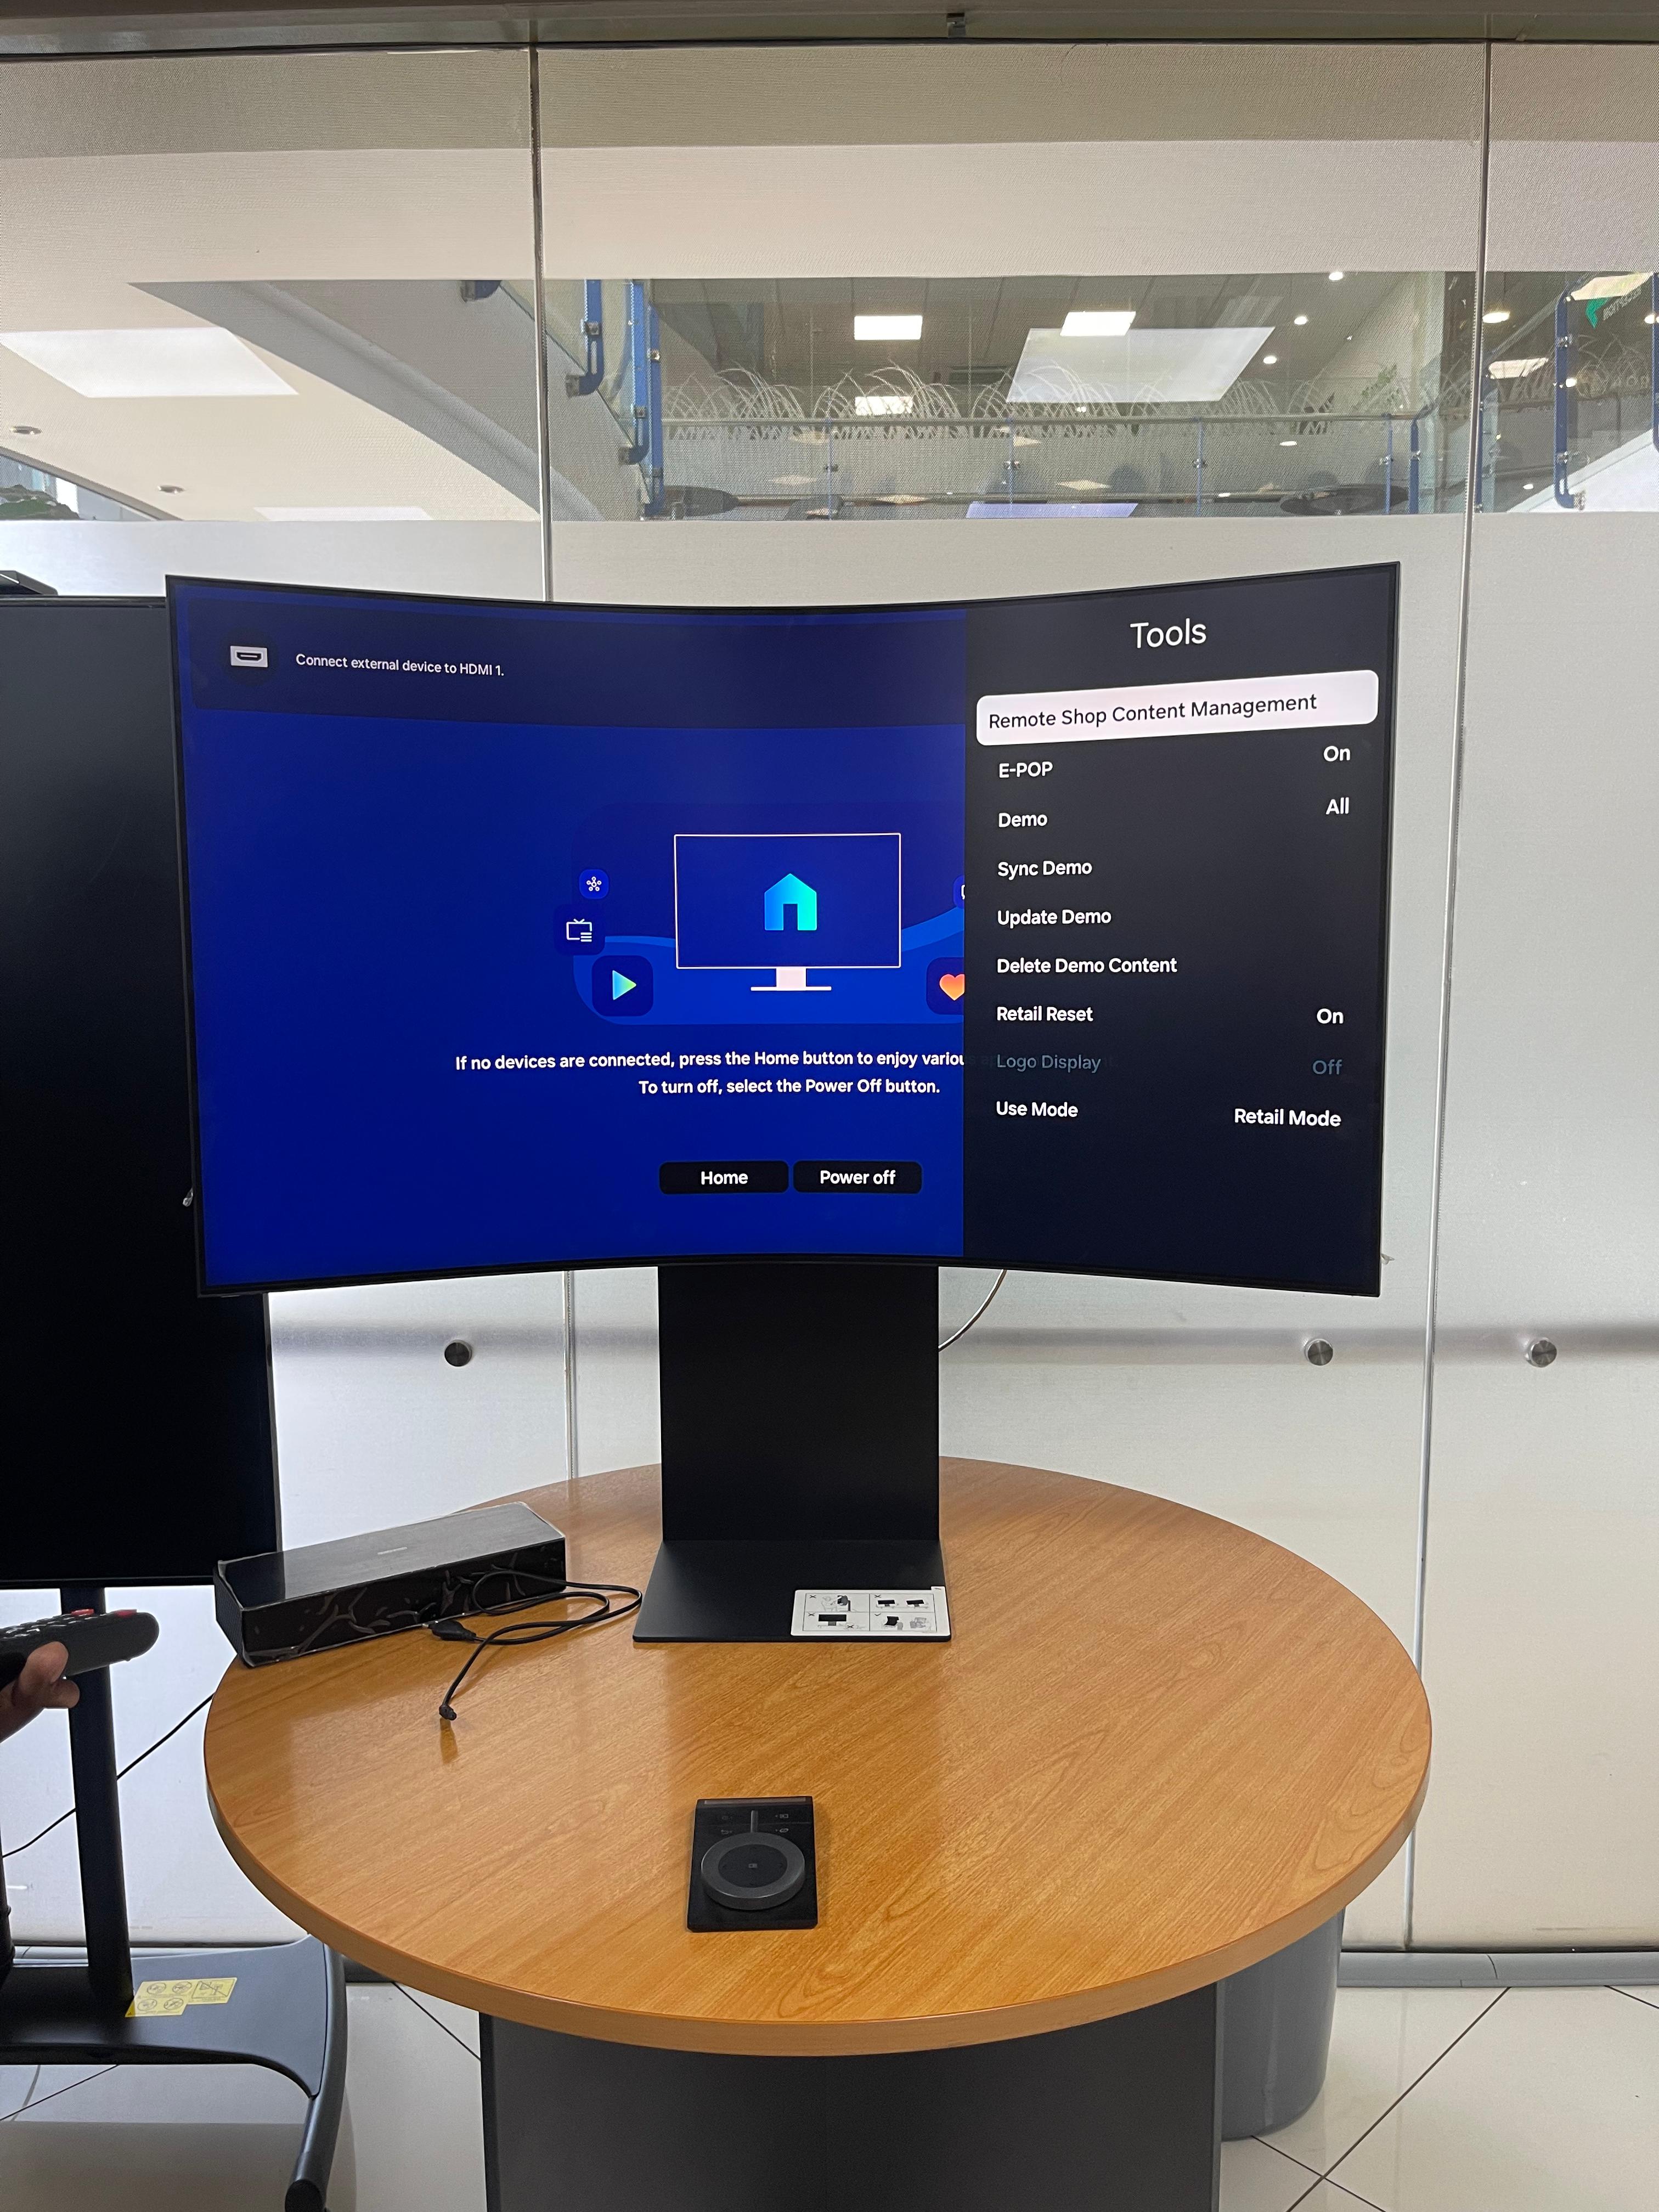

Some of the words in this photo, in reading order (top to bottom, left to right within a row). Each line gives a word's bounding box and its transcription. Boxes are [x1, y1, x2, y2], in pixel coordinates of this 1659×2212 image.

[1130, 618, 1207, 648] Tools
[296, 653, 348, 668] Connect
[351, 658, 399, 670] external
[402, 660, 442, 673] device
[444, 663, 457, 674] to
[460, 663, 493, 675] HDMI
[495, 665, 504, 676] 1.
[990, 712, 1056, 729] Remote
[1062, 708, 1107, 727] Shop
[1113, 703, 1186, 722] Content
[1192, 694, 1317, 718] Management
[1323, 745, 1351, 762] On
[999, 761, 1053, 778] E-POP
[1325, 797, 1350, 815] All
[998, 812, 1048, 828] Demo
[997, 861, 1039, 881] Sync
[1043, 860, 1093, 876] Demo
[997, 909, 1058, 929] Update
[1062, 909, 1111, 924] Demo
[997, 957, 1051, 974] Delete
[1055, 958, 1105, 973] Demo
[1108, 957, 1178, 973] Content
[997, 1005, 1042, 1021] Retail
[1046, 1006, 1094, 1022] Reset
[1316, 1008, 1344, 1024] On
[456, 1056, 467, 1070] If
[471, 1058, 492, 1070] no
[494, 1054, 556, 1069] devices
[560, 1056, 585, 1068] are
[589, 1052, 675, 1068] connected,
[679, 1054, 721, 1069] press
[725, 1051, 751, 1065] the
[754, 1051, 799, 1065] Home
[803, 1051, 854, 1065] button
[856, 1052, 873, 1065] to
[876, 1051, 918, 1069] enjoy
[997, 1054, 1037, 1072] Logo
[1042, 1054, 1101, 1074] Display
[1312, 1059, 1342, 1075] Off
[638, 1080, 658, 1094] To
[661, 1081, 693, 1094] turn
[697, 1079, 723, 1095] off,
[726, 1079, 773, 1093] select
[776, 1078, 802, 1092] the
[805, 1079, 854, 1092] Power
[857, 1078, 882, 1093] Off
[885, 1079, 940, 1093] button.
[996, 1101, 1028, 1116] Use
[1031, 1102, 1079, 1118] Mode
[1234, 1108, 1284, 1125] Retail
[1289, 1110, 1342, 1127] Mode
[701, 1171, 748, 1185] Home
[820, 1170, 870, 1184] Power
[873, 1169, 896, 1185] off
